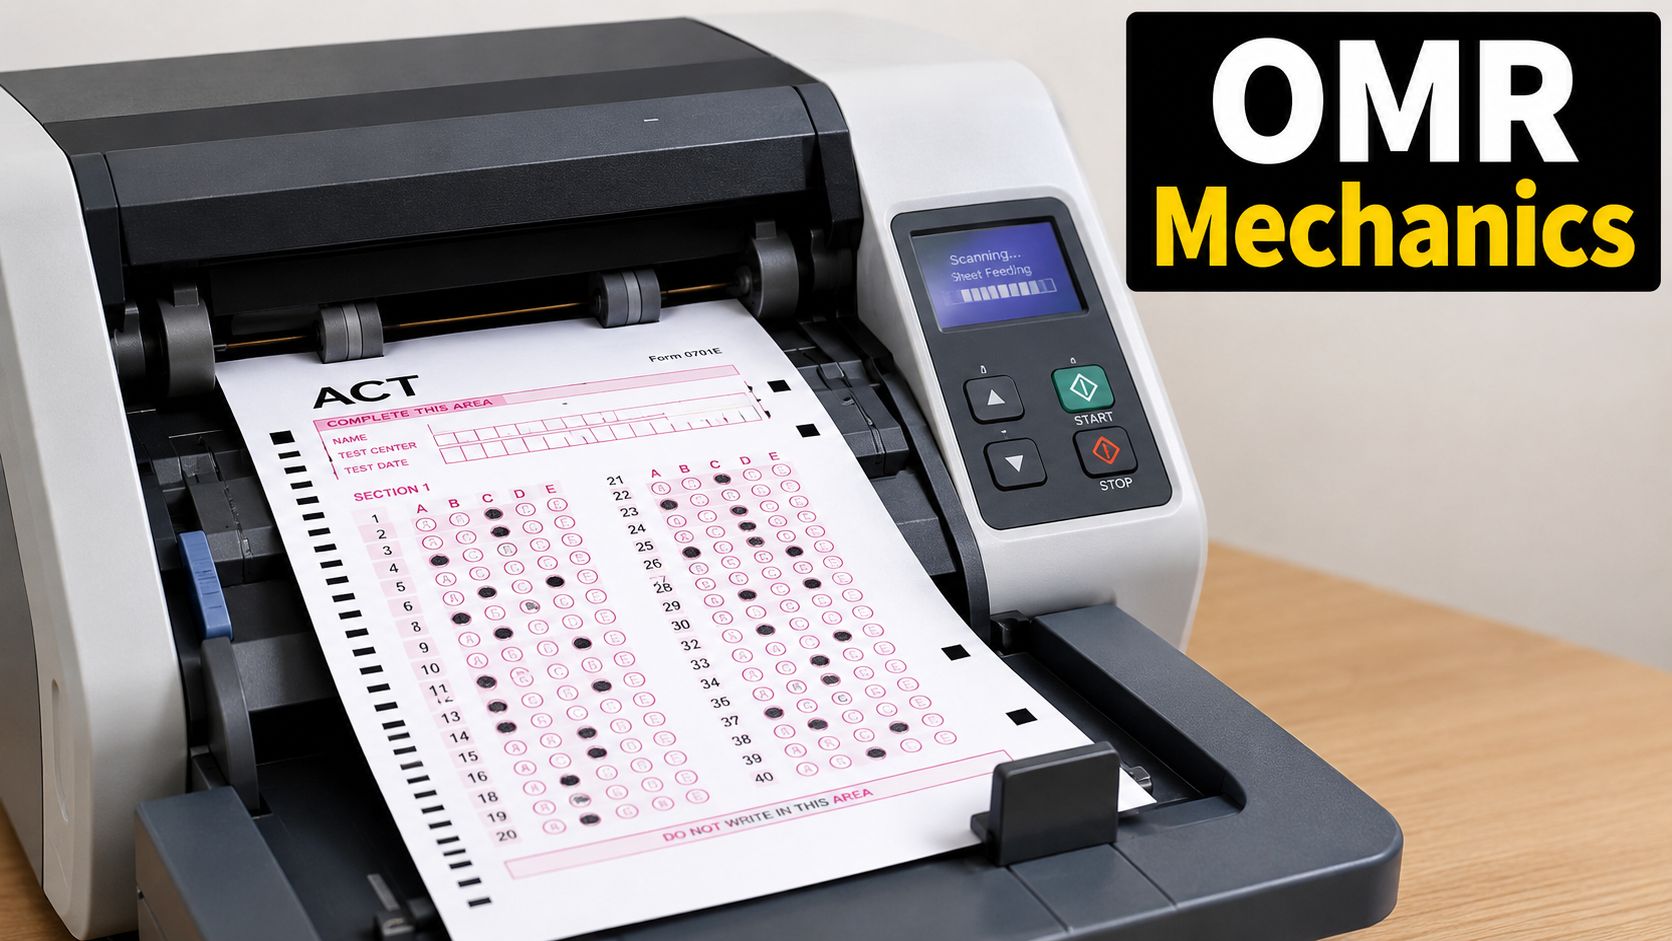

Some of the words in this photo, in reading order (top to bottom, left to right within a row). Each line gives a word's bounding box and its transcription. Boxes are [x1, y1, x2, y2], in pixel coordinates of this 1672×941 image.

[950, 249, 1021, 266] Scanning...
[649, 353, 682, 363] Form
[684, 347, 723, 358] 0701E
[313, 375, 419, 409] ACT
[327, 410, 410, 428] COMPLETE
[414, 404, 449, 415] THIS
[453, 399, 493, 410] AREA
[1074, 411, 1113, 426] START
[332, 434, 368, 445] NAME
[338, 449, 367, 460] TEST
[370, 442, 418, 455] CENTER
[344, 464, 374, 475] TEST
[377, 459, 410, 471] DATE
[651, 469, 661, 478] A
[679, 464, 690, 473] B
[710, 460, 720, 468] C
[740, 456, 752, 464] D
[768, 452, 780, 461] E
[606, 476, 624, 486] 21
[1099, 477, 1134, 491] STOP
[354, 485, 419, 502] SECTION
[423, 483, 430, 492] 1
[613, 490, 632, 501] 22
[416, 504, 428, 514] A
[448, 499, 460, 508] B
[482, 494, 494, 502] C
[514, 490, 526, 498] D
[546, 484, 556, 494] E
[372, 514, 379, 523] 1
[620, 507, 638, 518] 23
[376, 529, 386, 540] 2
[628, 524, 646, 534] 24
[382, 546, 392, 556] 3
[636, 541, 654, 552] 25
[389, 564, 398, 573] 4
[644, 559, 662, 570] 26
[396, 582, 406, 592] 5
[404, 601, 413, 612] 6
[662, 601, 680, 612] 29
[672, 620, 690, 630] 30
[419, 642, 429, 654] 9
[681, 639, 701, 651] 32
[420, 662, 440, 675] 10
[690, 658, 710, 670] 33
[700, 678, 720, 689] 34
[429, 684, 448, 696] 11
[441, 711, 461, 724] 13
[721, 716, 739, 727] 37
[450, 731, 470, 744] 14
[732, 734, 751, 746] 38
[458, 750, 478, 763] 15
[742, 754, 762, 765] 39
[468, 771, 488, 784] 16
[755, 772, 774, 784] 40
[478, 792, 498, 804] 18
[488, 811, 506, 823] 19
[662, 830, 687, 842] DO
[690, 822, 722, 836] NOT
[725, 810, 774, 828] WRITE
[775, 807, 793, 817] IN
[794, 798, 829, 812] THIS
[832, 788, 874, 804] AREA
[496, 830, 518, 842] 20
